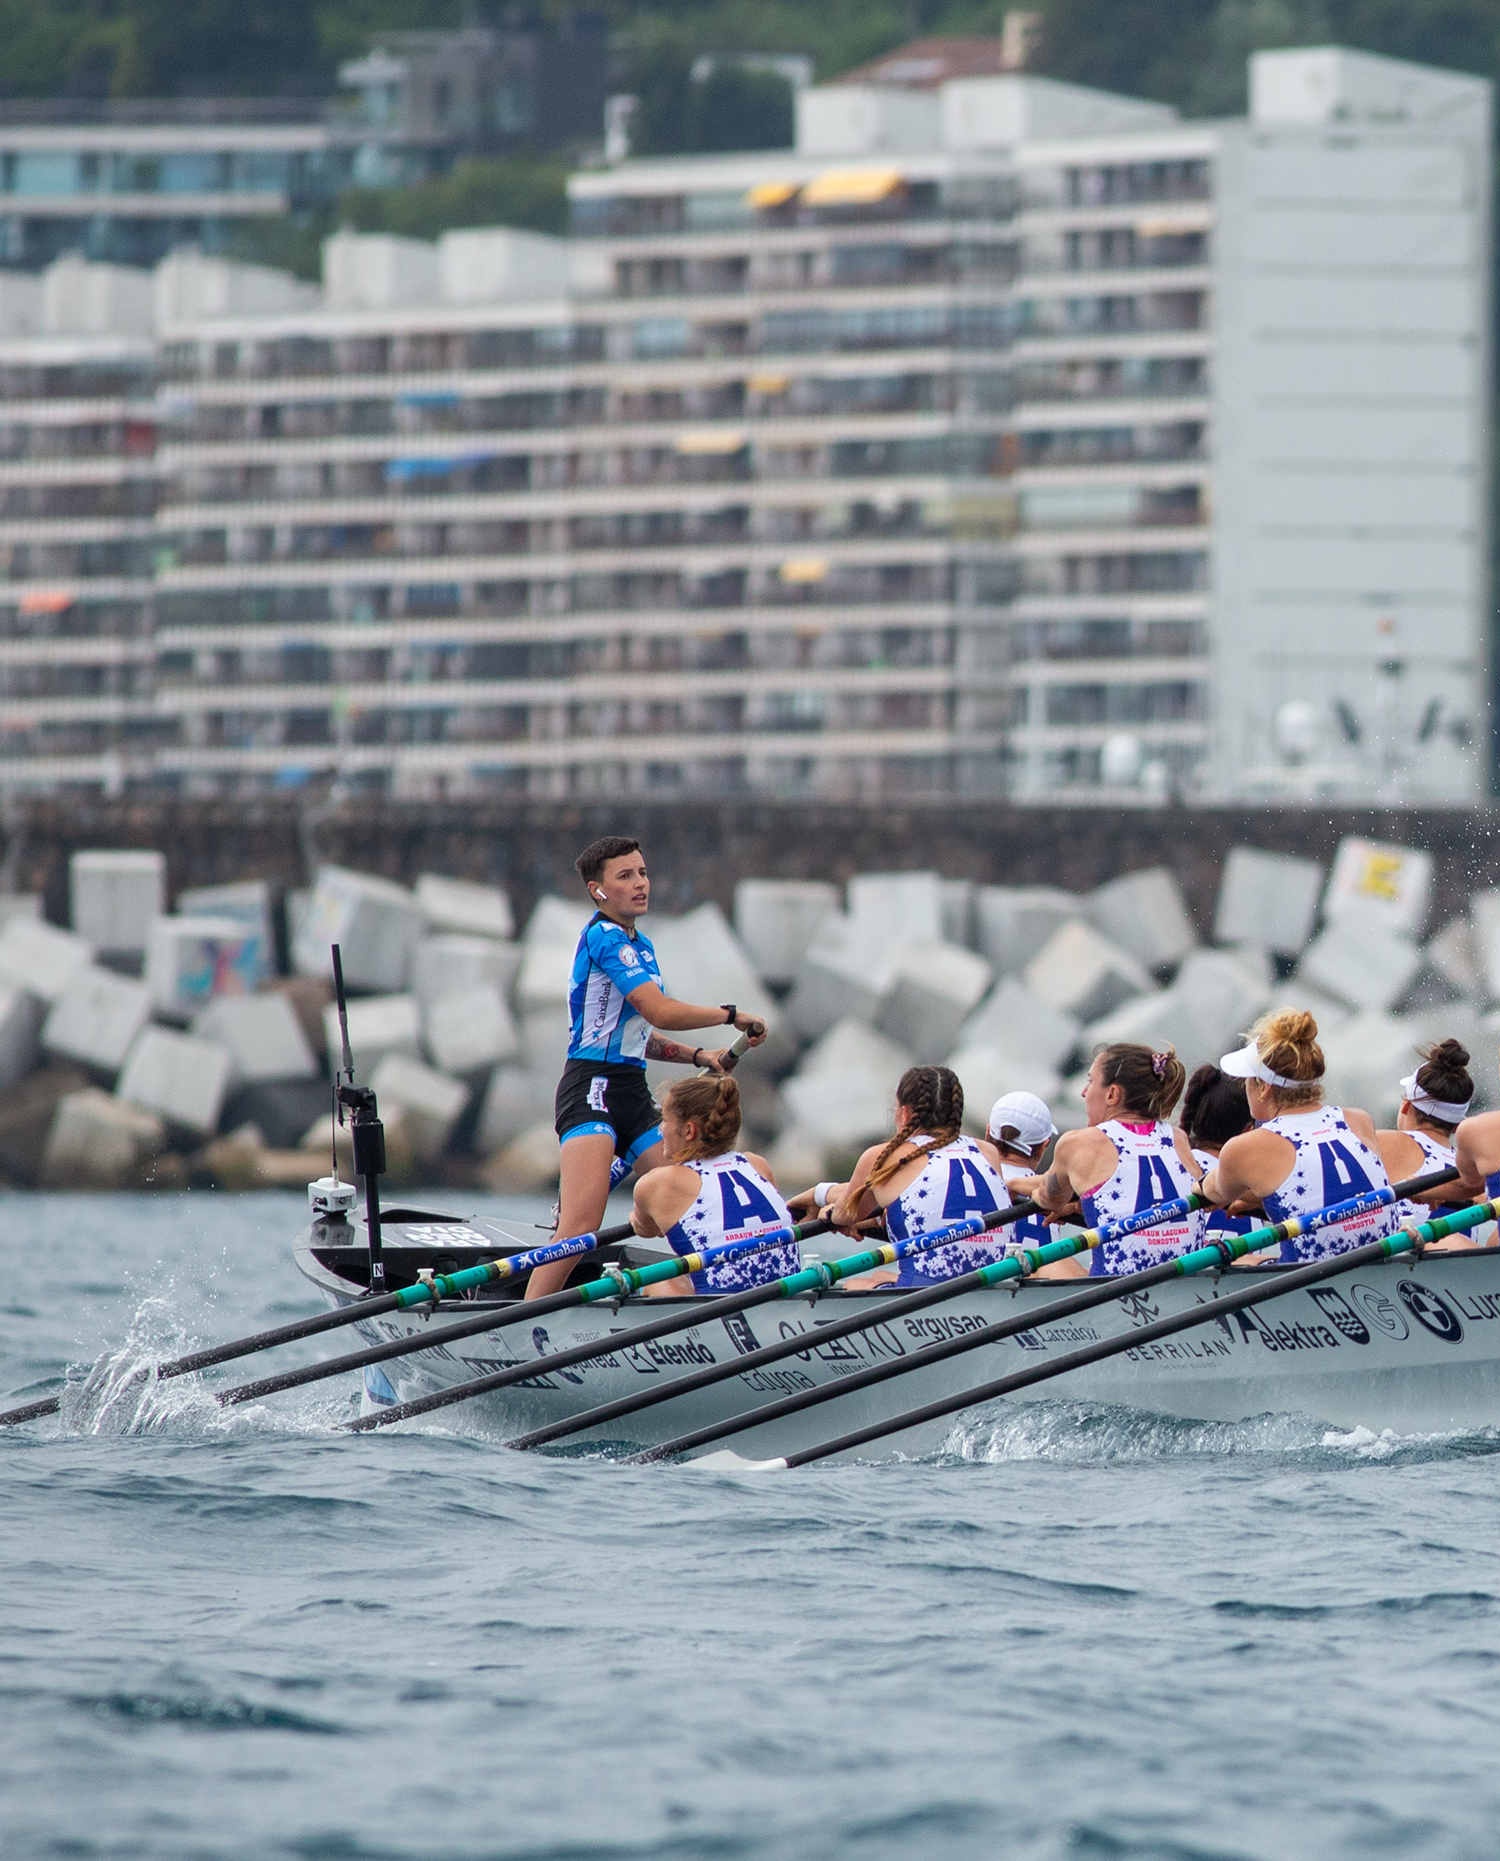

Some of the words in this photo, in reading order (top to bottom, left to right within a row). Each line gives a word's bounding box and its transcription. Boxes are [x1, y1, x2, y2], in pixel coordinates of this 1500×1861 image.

[594, 980, 612, 1028] CaixaBank
[1123, 1203, 1182, 1232] CaixaBank
[1326, 1194, 1385, 1224] CaixaBank
[725, 1231, 754, 1241] ARRAUN
[919, 1223, 975, 1250] CaixaBank
[1161, 1227, 1190, 1237] LAGUNAK
[1342, 1217, 1376, 1232] DONOSTIA
[533, 1239, 587, 1263] CaixaBank
[729, 1236, 785, 1261] CaixaBank
[1147, 1237, 1181, 1246] DONOSTIA
[903, 1312, 989, 1340] argysan
[1250, 1305, 1341, 1352] elektra
[642, 1336, 717, 1365] Etendo
[1124, 1340, 1231, 1361] BERRILAN
